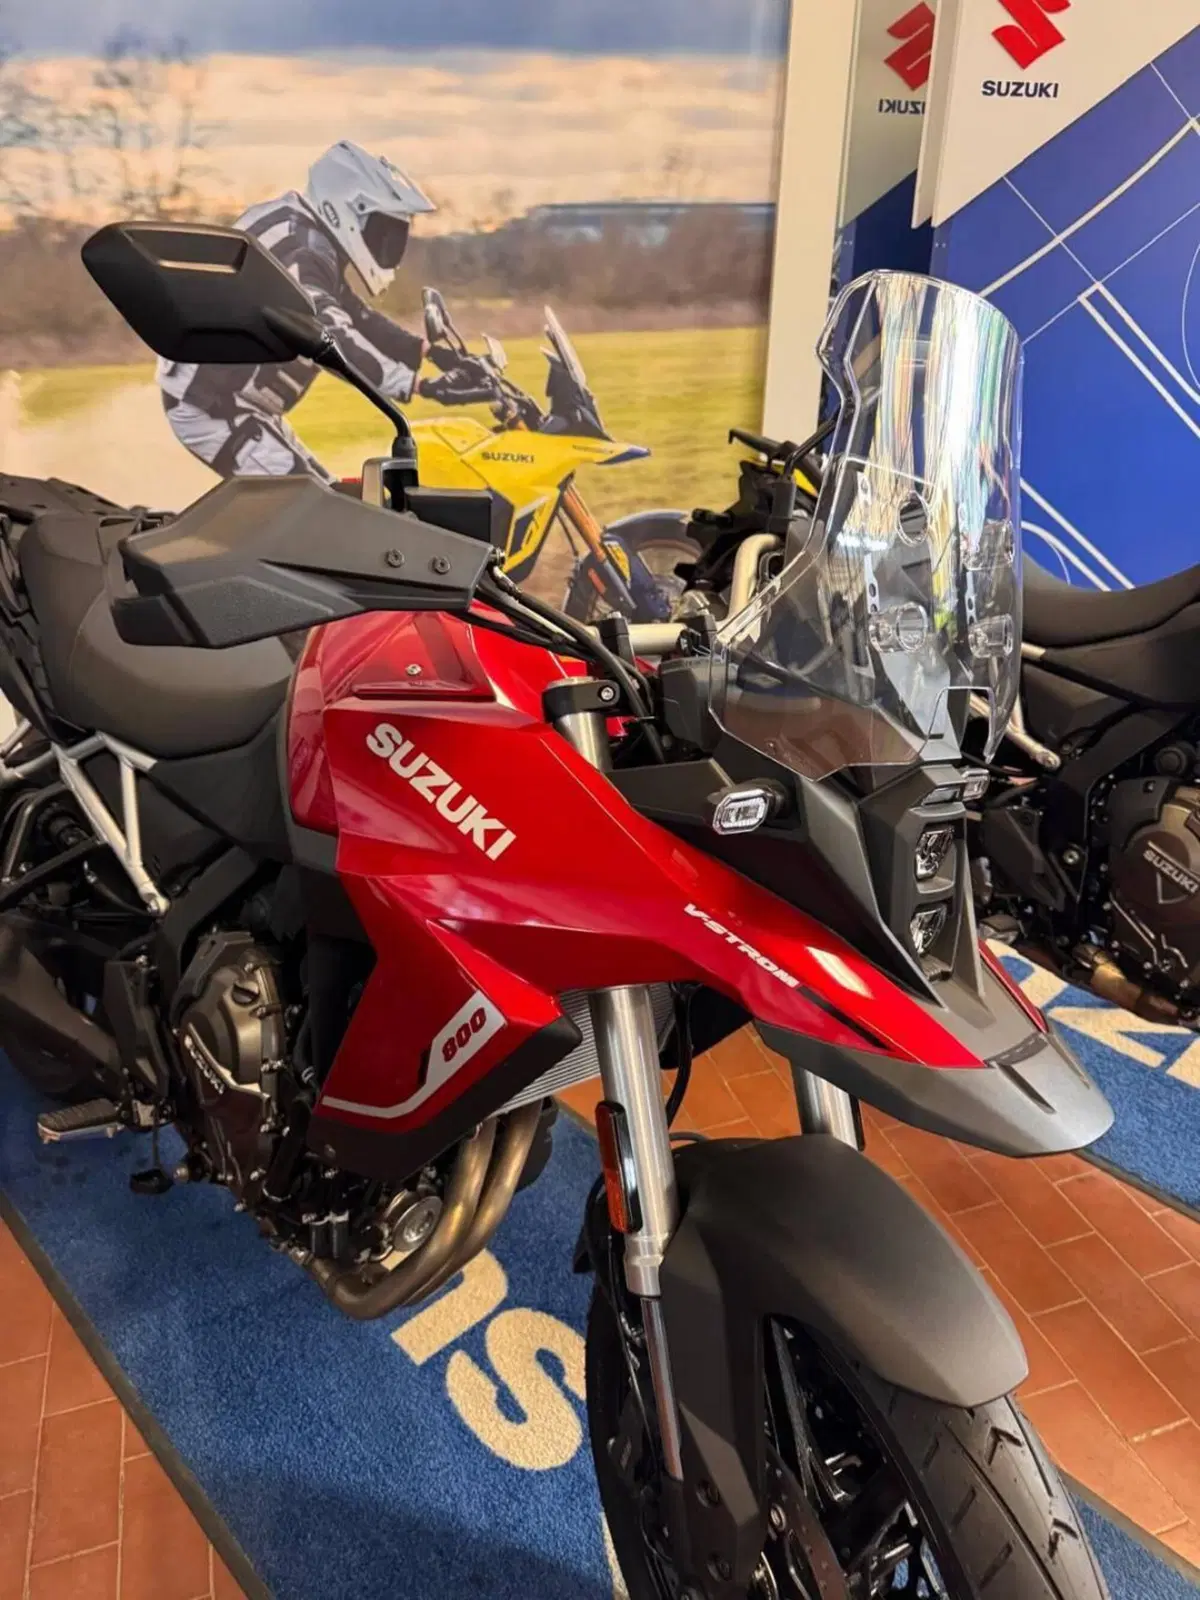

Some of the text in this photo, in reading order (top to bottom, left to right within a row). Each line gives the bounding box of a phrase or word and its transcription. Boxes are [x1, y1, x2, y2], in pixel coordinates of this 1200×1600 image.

[982, 80, 1059, 98] SUZUKI
[481, 451, 535, 464] SUZUKI
[366, 722, 517, 861] SUZUKI
[1143, 849, 1199, 893] SUZUKI
[683, 903, 800, 988] V-STROM
[442, 1006, 487, 1063] 800
